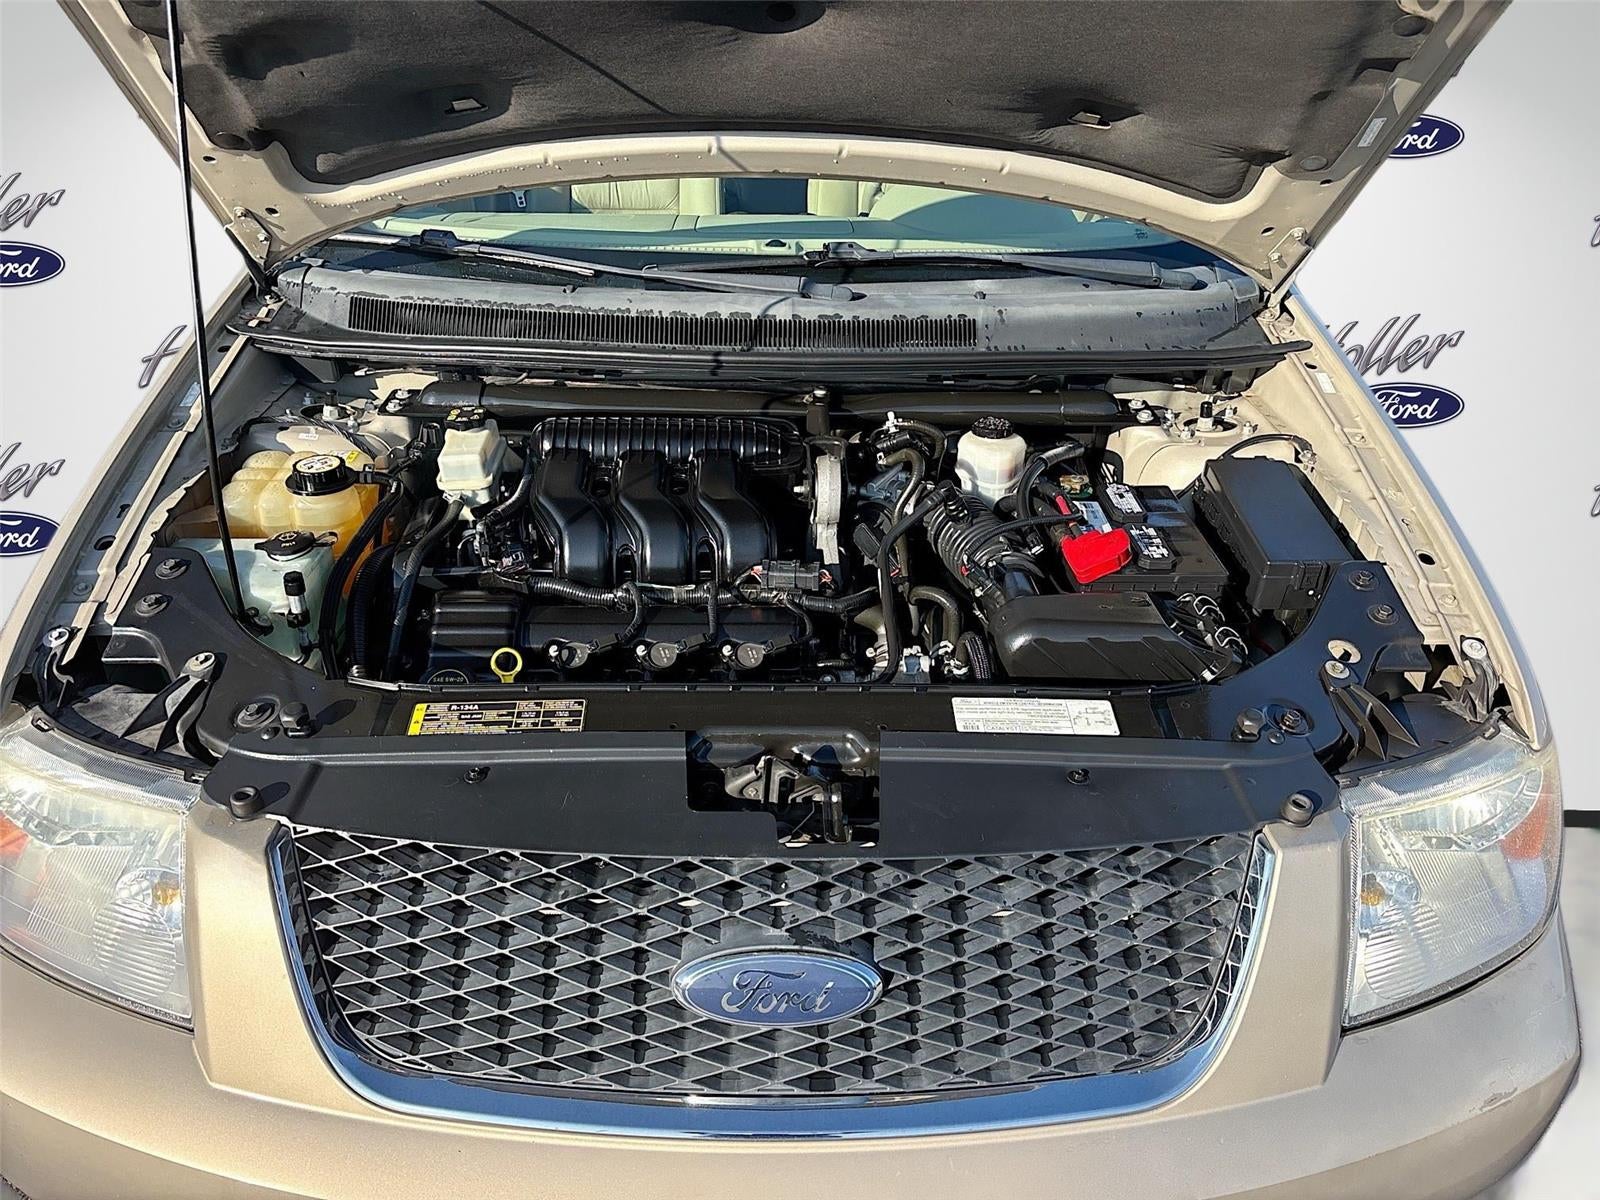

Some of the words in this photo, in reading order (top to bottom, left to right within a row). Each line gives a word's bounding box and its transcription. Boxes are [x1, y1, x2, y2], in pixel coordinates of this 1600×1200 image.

[1395, 121, 1440, 149] rd
[1375, 390, 1440, 419] Ford
[721, 969, 835, 1014] Ford
